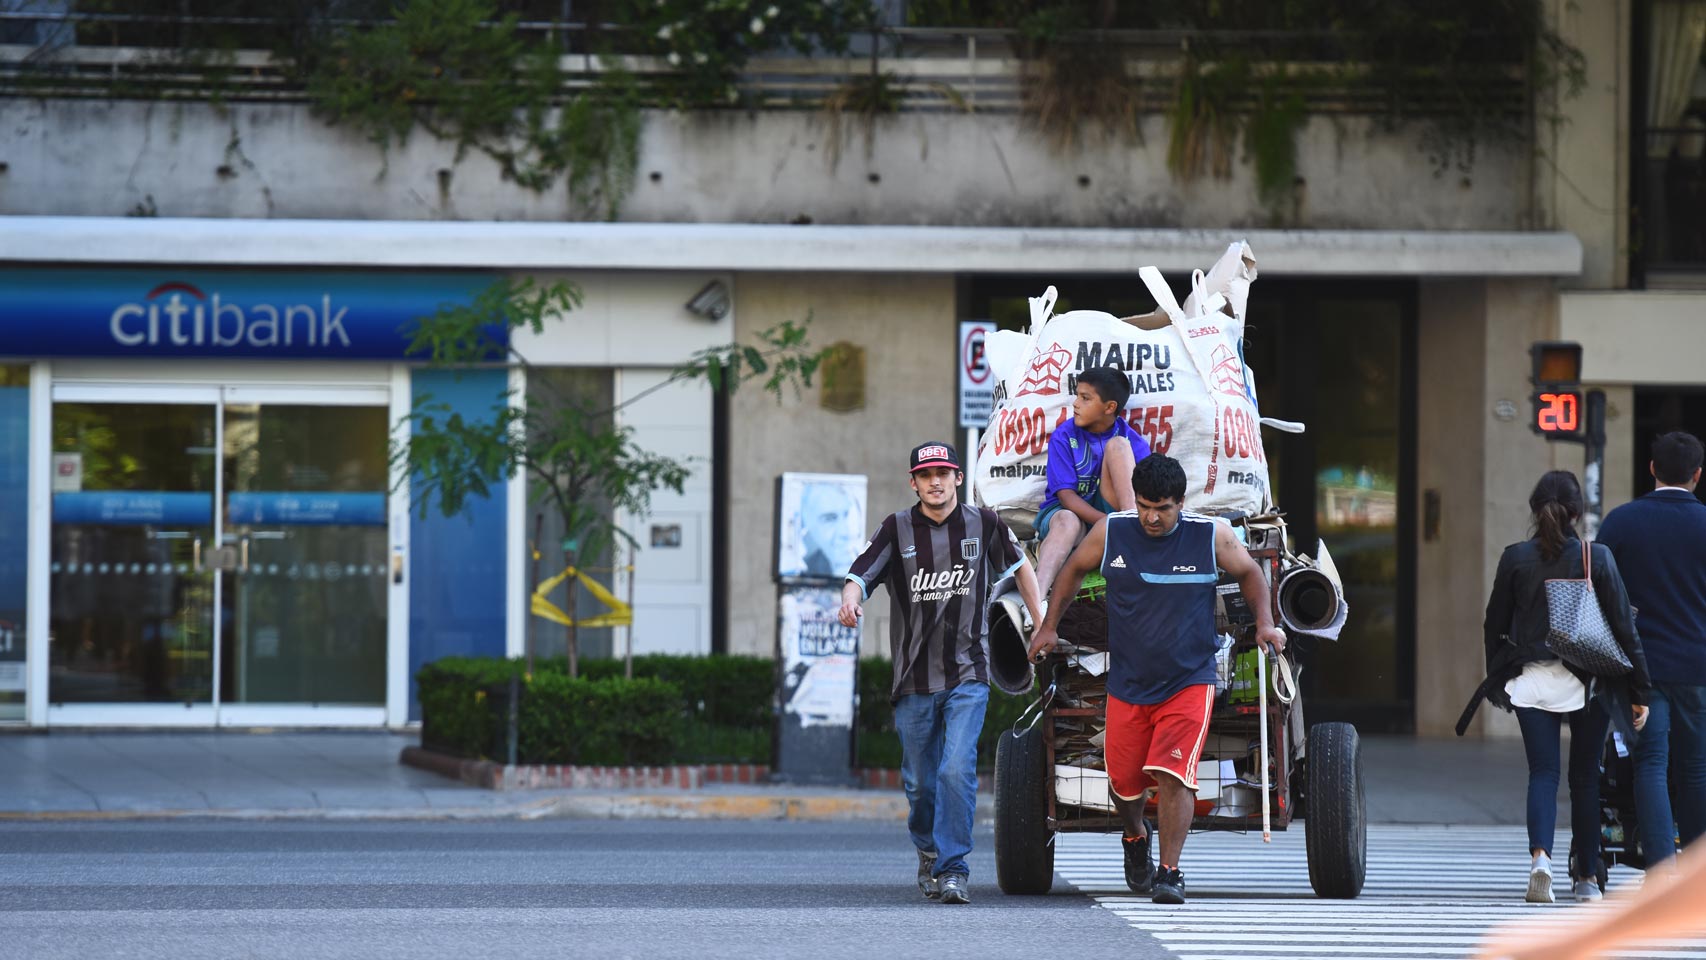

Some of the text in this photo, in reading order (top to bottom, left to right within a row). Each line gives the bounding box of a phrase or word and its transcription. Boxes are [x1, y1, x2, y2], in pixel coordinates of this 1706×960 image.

[110, 293, 350, 347] citibank
[1075, 341, 1171, 371] MAIPU
[1068, 372, 1175, 396] MIALES
[1538, 393, 1577, 431] 20
[919, 447, 946, 458] OBEY
[910, 564, 976, 593] dueño
[912, 592, 922, 603] de
[922, 591, 944, 601] una
